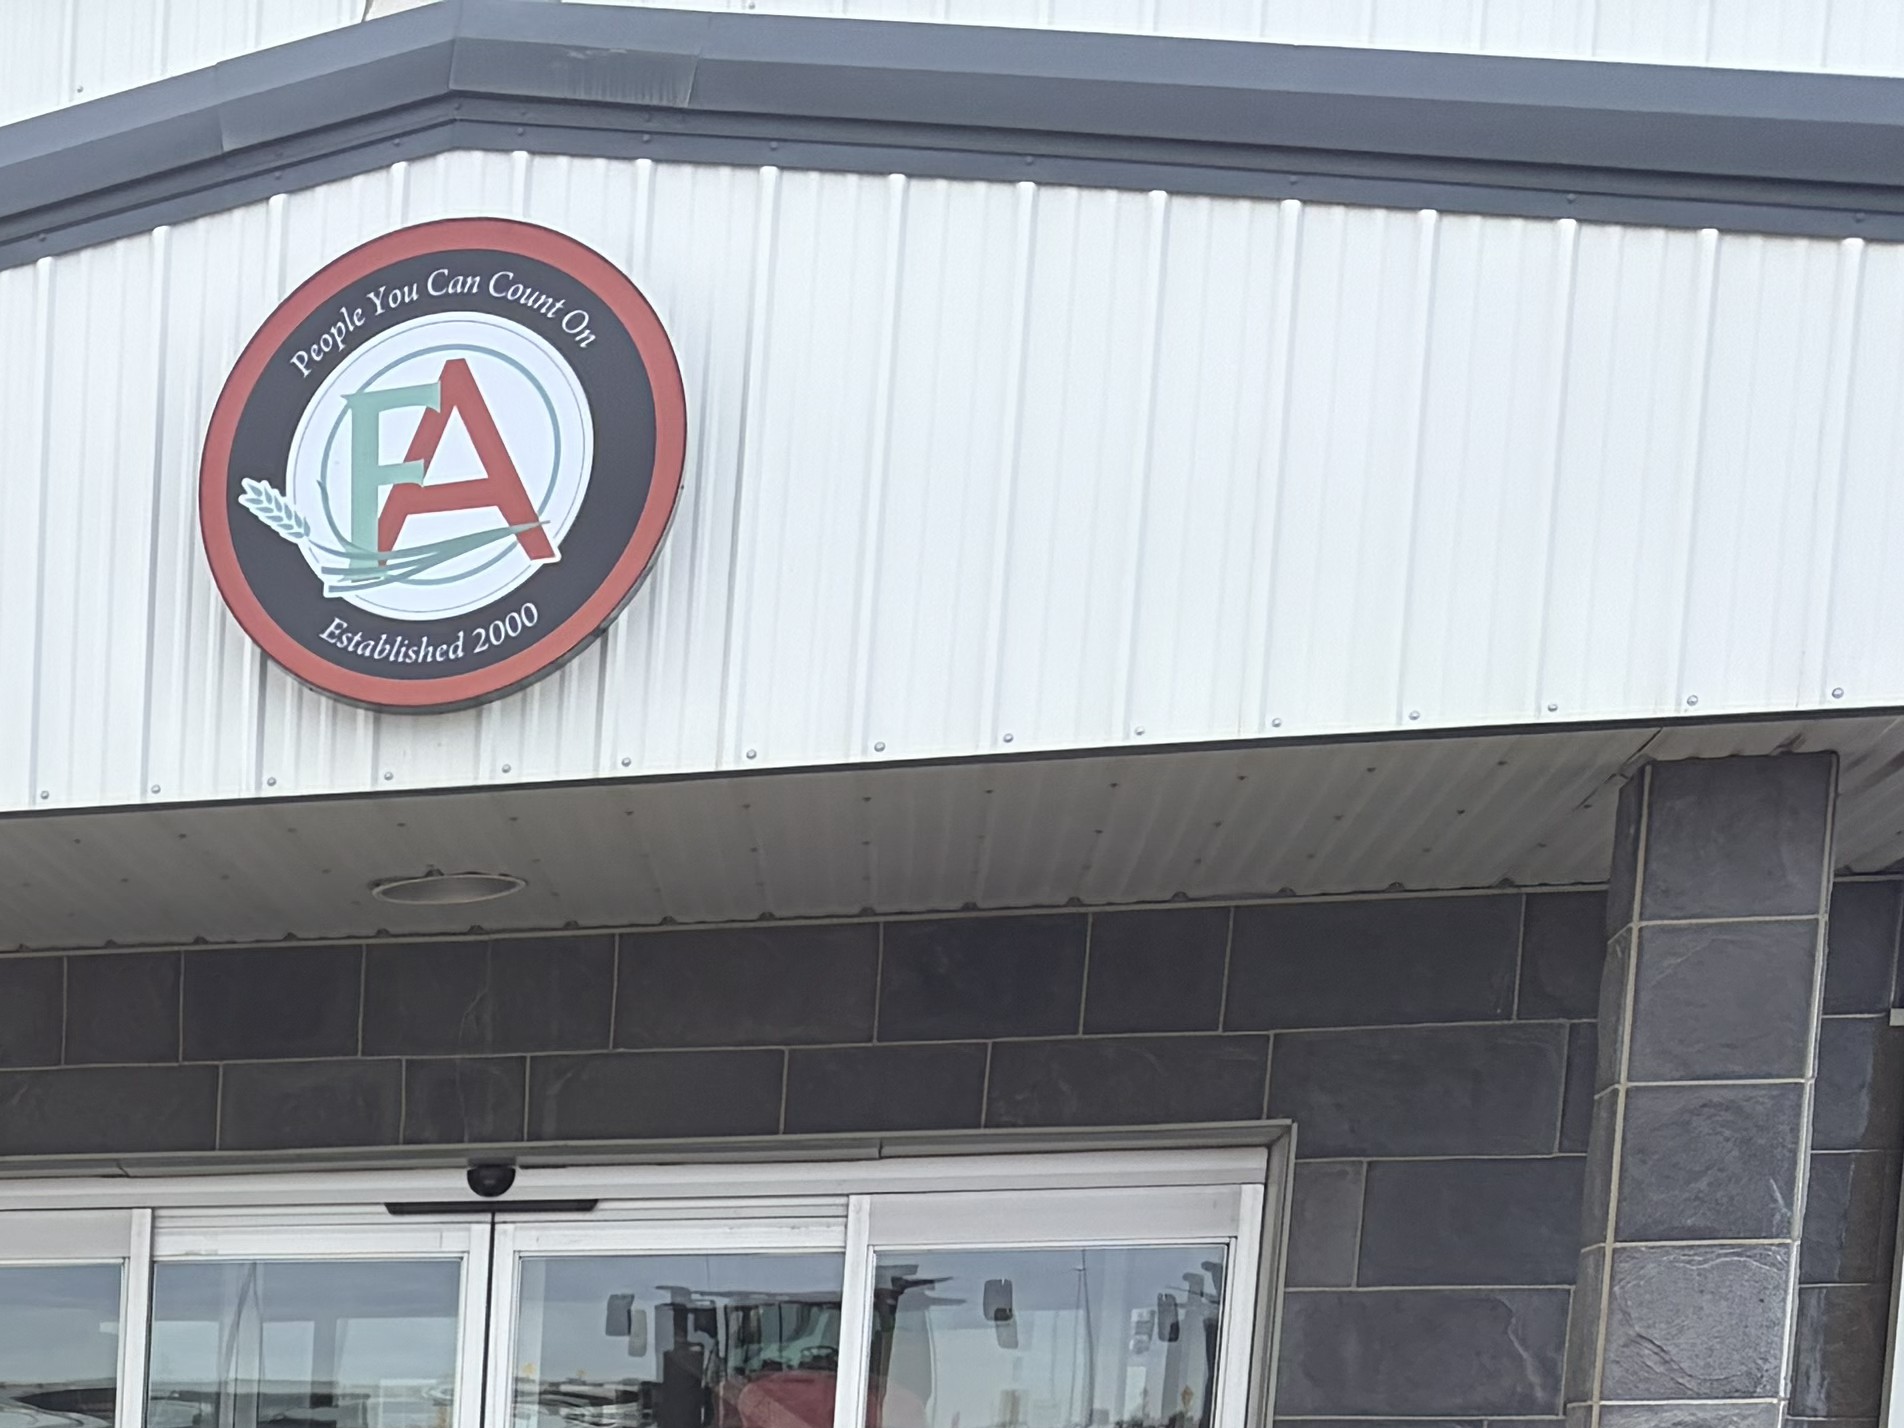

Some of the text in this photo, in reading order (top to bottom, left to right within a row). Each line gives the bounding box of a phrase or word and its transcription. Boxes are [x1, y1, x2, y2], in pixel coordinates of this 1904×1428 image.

[290, 267, 598, 380] People You Can Count On
[320, 600, 541, 664] Established 2000
